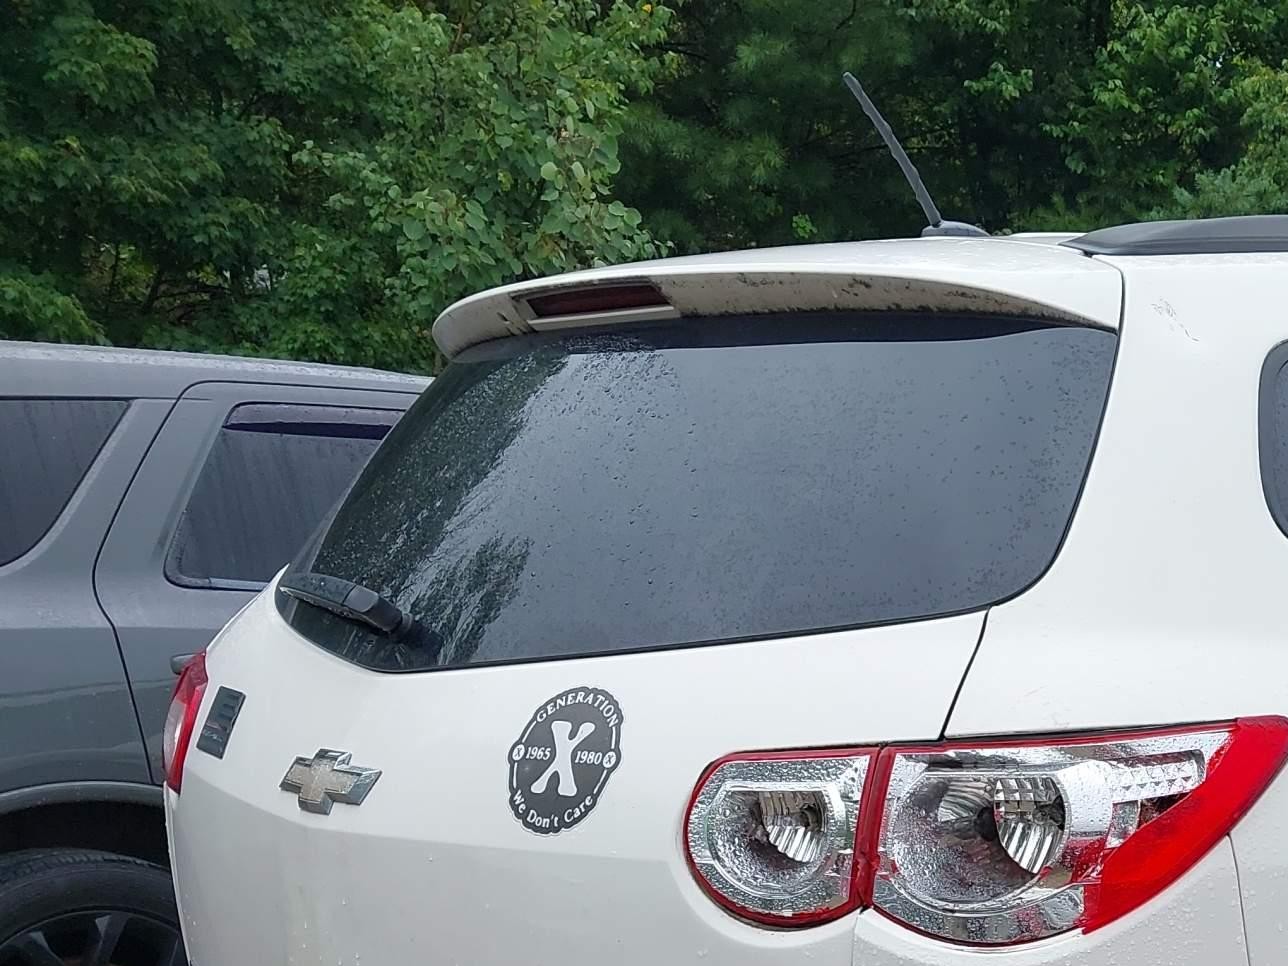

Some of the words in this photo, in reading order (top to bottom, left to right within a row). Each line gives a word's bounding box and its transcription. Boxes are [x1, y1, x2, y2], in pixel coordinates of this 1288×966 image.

[537, 692, 618, 727] GENERATION
[525, 746, 551, 760] 1965
[531, 720, 595, 796] X
[574, 751, 602, 765] 1980
[513, 790, 526, 813] We
[527, 810, 559, 828] Don't
[564, 796, 593, 822] Care
